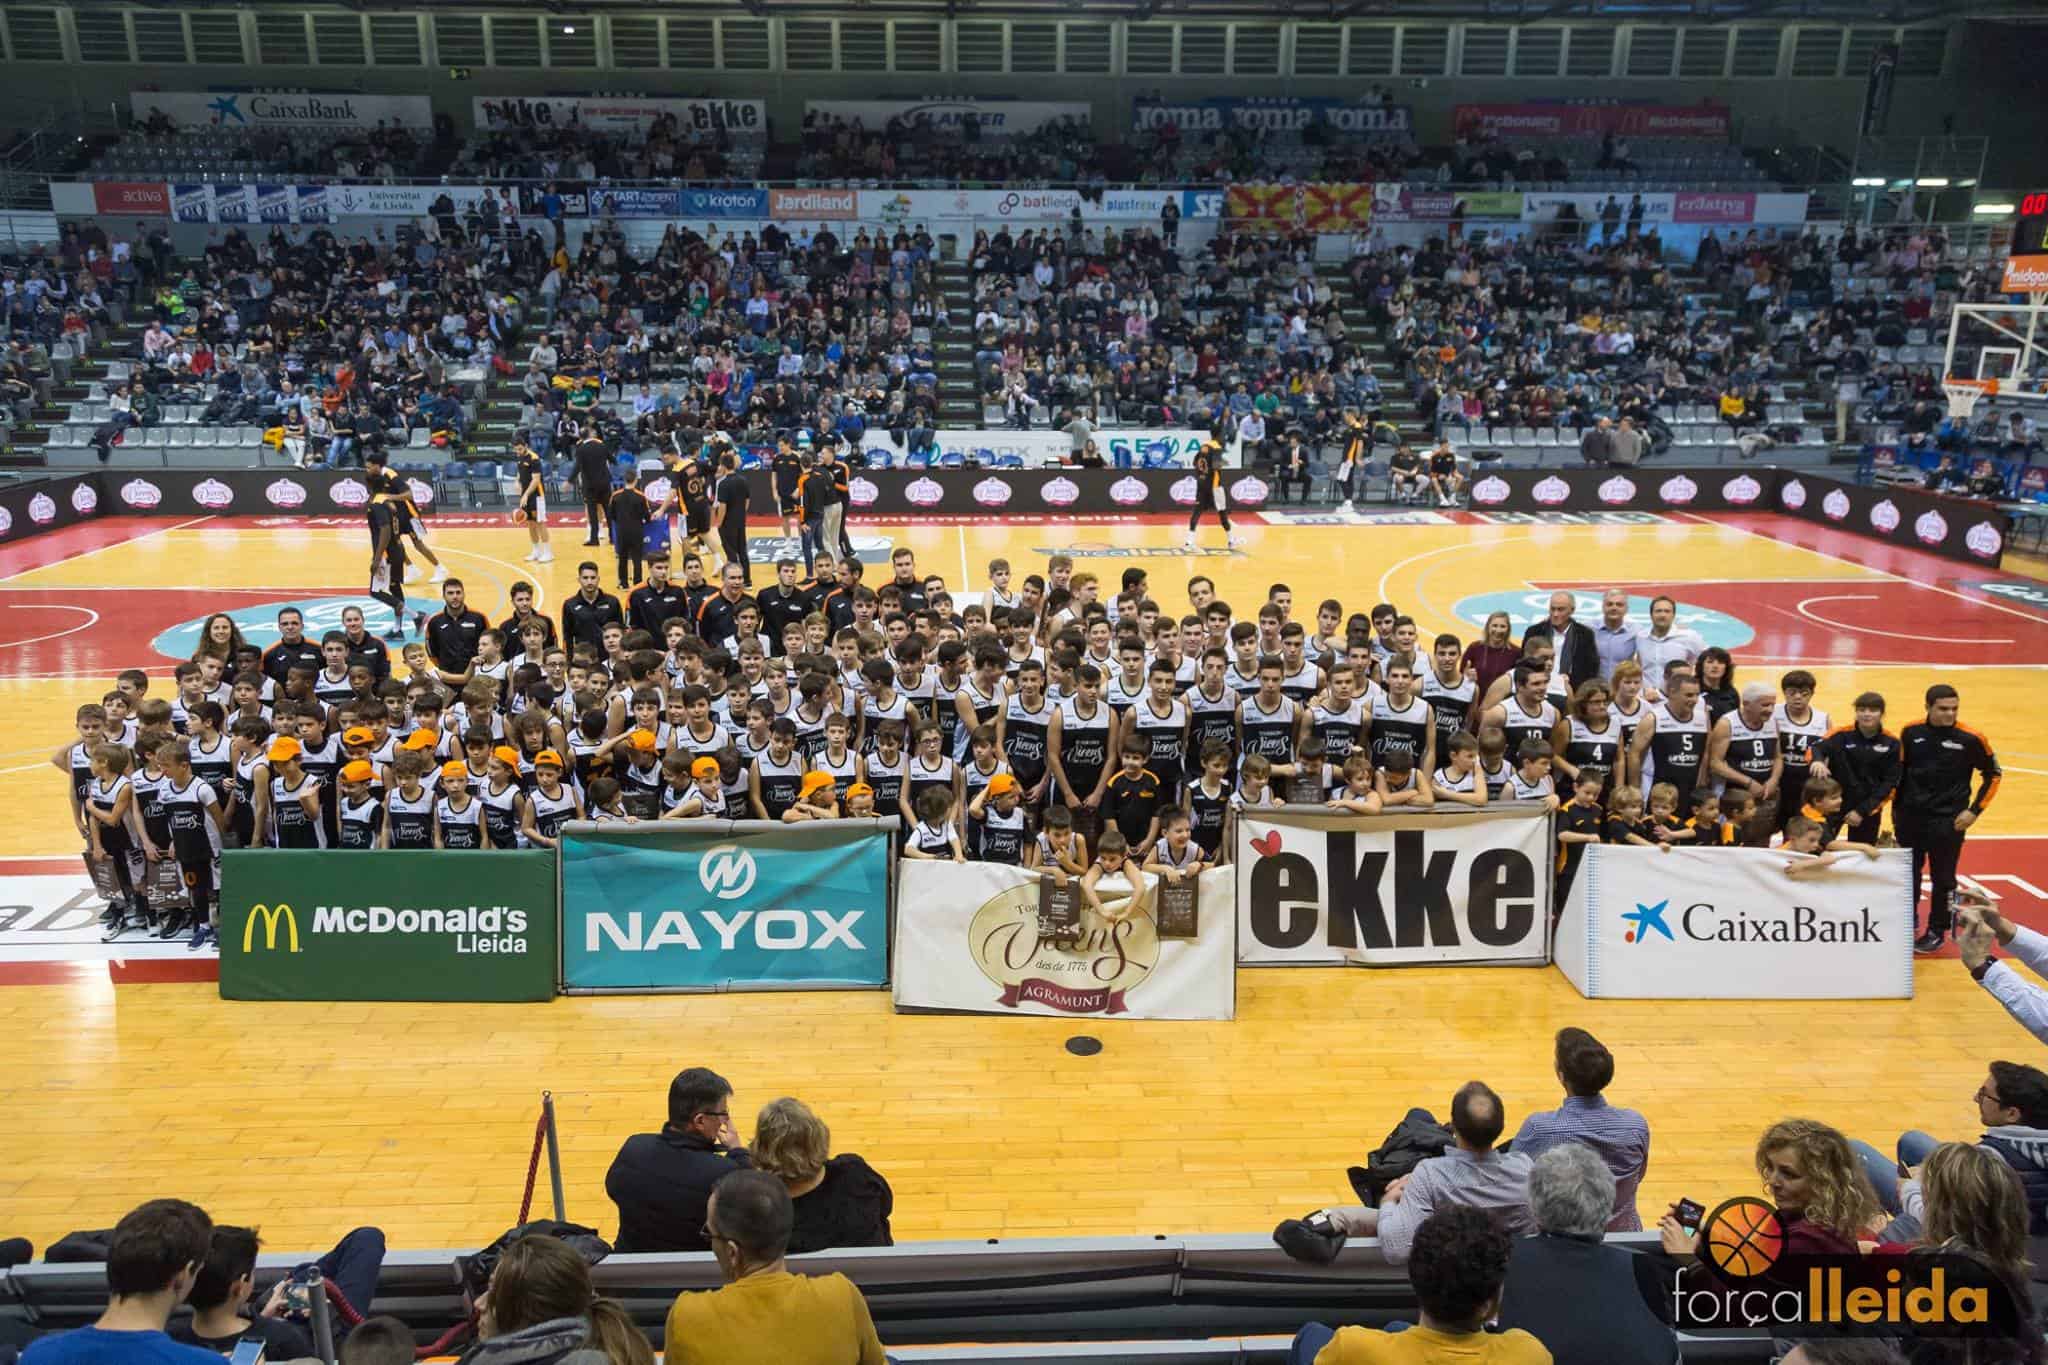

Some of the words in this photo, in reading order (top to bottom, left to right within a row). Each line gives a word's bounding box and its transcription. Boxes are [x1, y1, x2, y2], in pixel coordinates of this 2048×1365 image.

[250, 96, 357, 121] CaixaBank
[122, 189, 162, 202] activa
[368, 192, 421, 200] Universitat
[709, 193, 756, 208] kroton
[776, 194, 852, 210] Jardiland
[1682, 733, 1694, 751] 5
[1786, 733, 1808, 751] 14
[1592, 743, 1603, 761] 4
[1250, 830, 1535, 949] ekke
[312, 906, 527, 933] McDonald's
[1682, 903, 1883, 943] CaixaBank
[586, 910, 866, 952] NAYOX
[456, 934, 527, 953] Lleida
[1023, 985, 1104, 1007] AGRAMUNT
